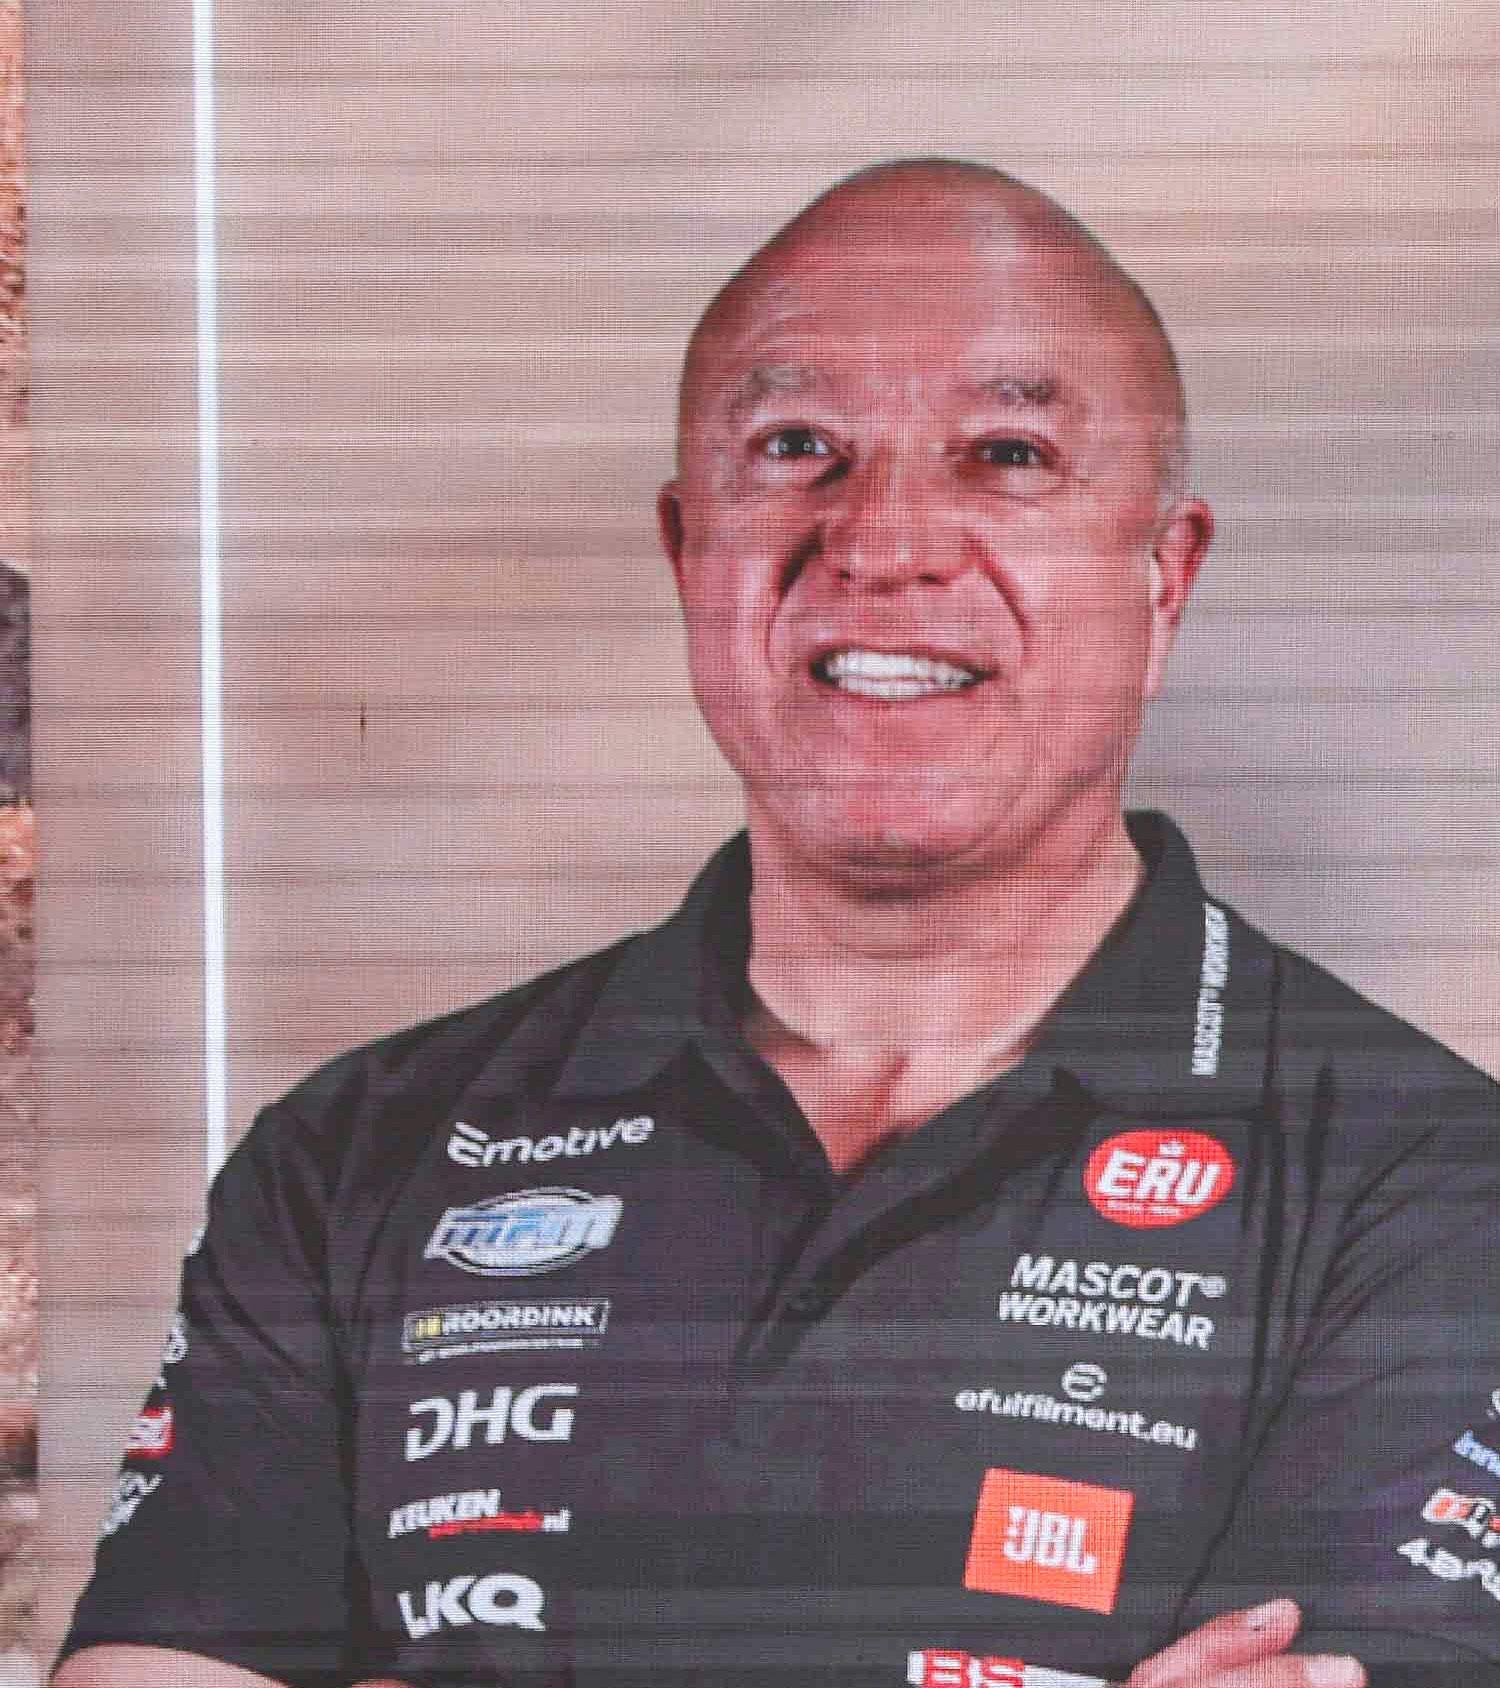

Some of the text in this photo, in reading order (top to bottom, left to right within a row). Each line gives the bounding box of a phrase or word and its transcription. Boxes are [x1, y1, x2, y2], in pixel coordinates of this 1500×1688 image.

[447, 1115, 656, 1168] Emotive
[1094, 1157, 1222, 1209] ERU
[999, 1292, 1216, 1351] WORKWEAR
[405, 1385, 579, 1462] DHG
[1003, 1506, 1098, 1576] JBL
[397, 1573, 547, 1640] LKQ
